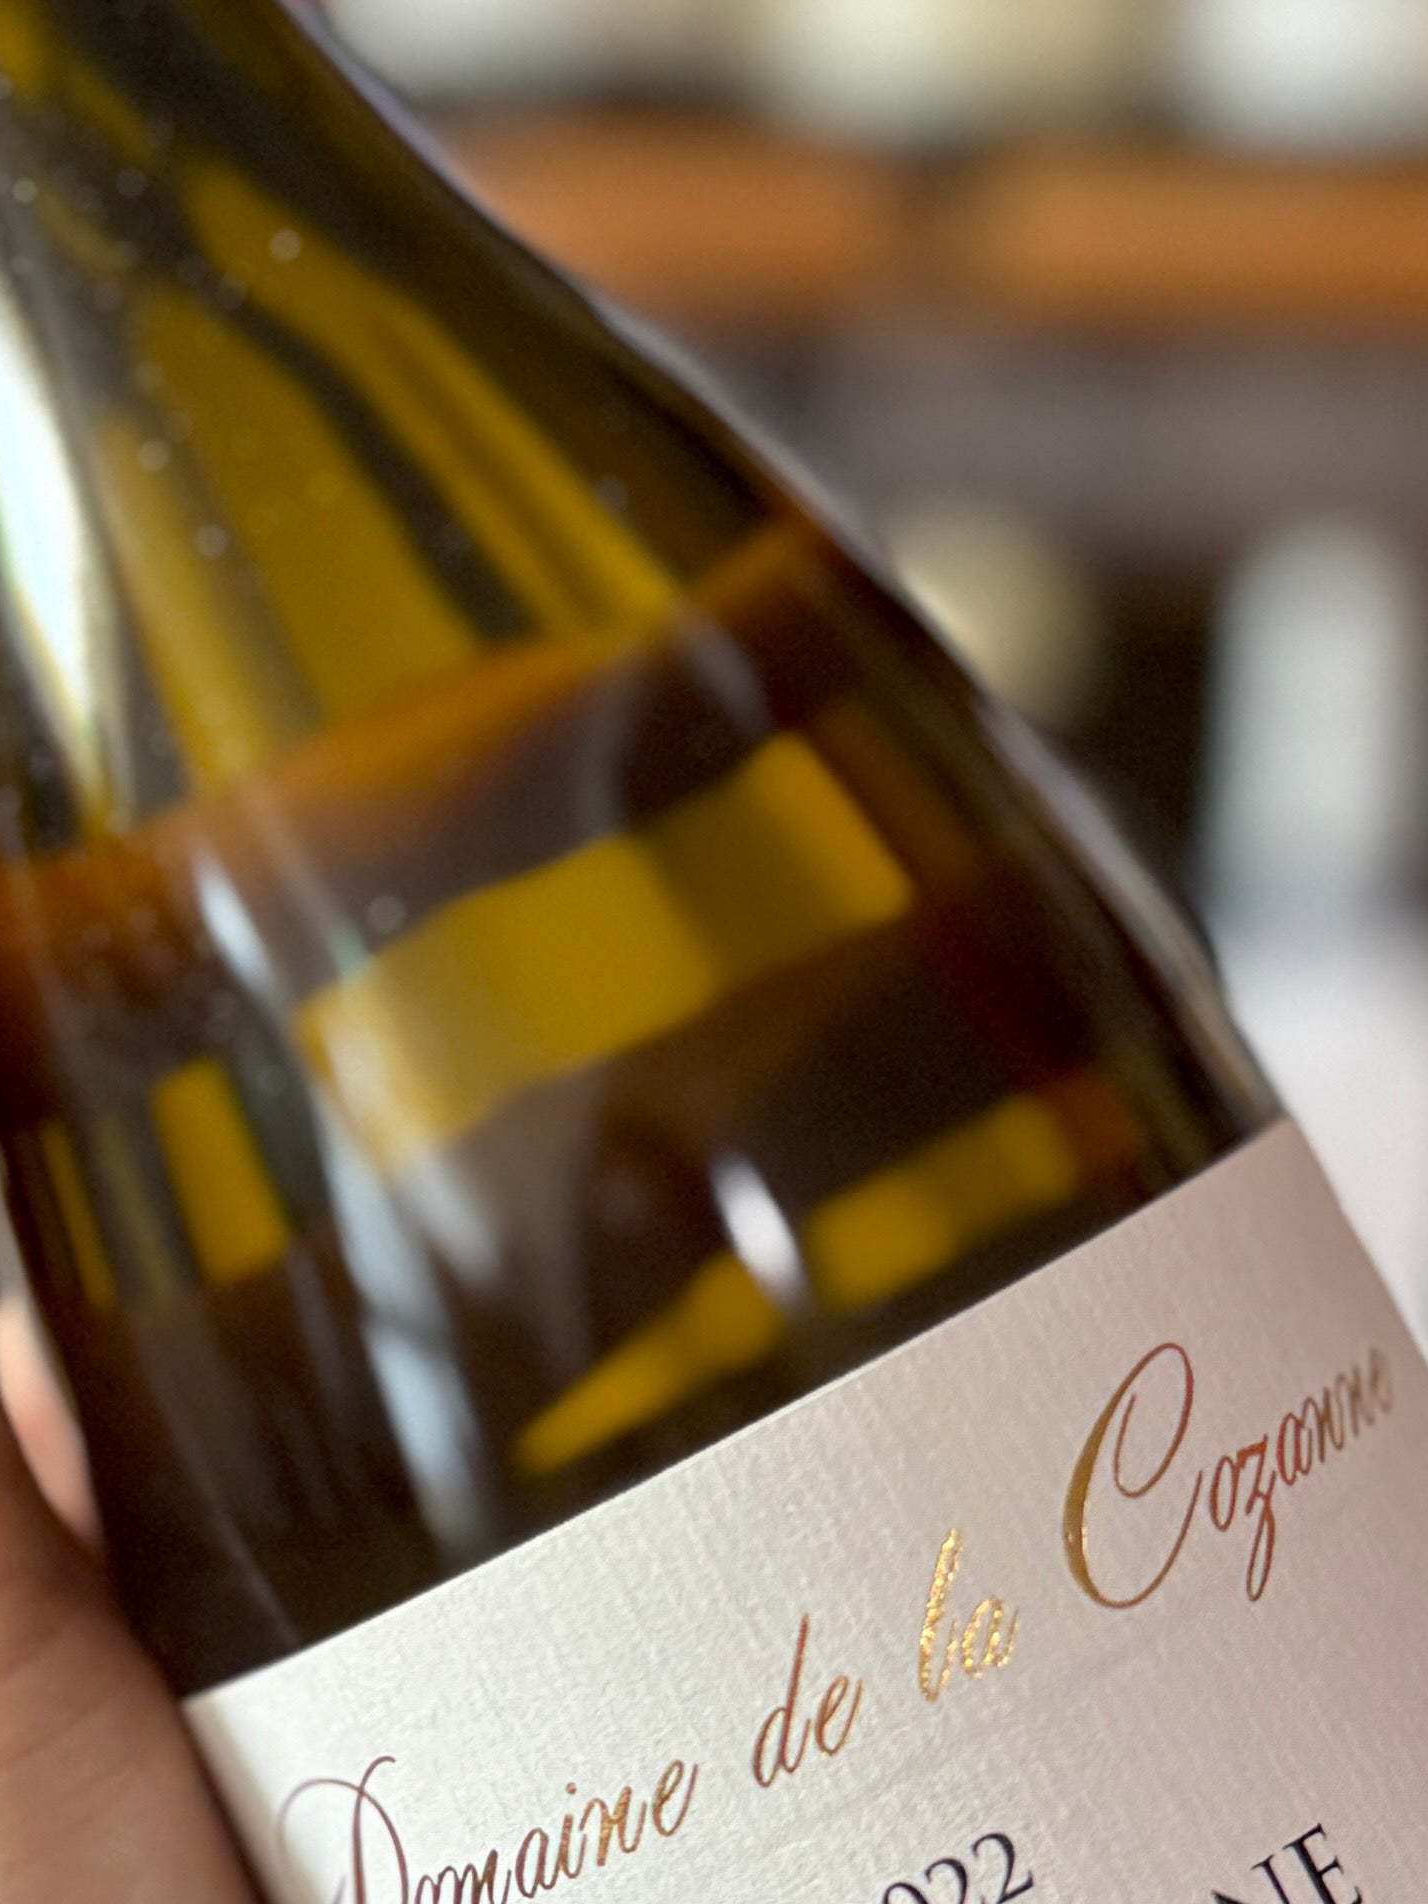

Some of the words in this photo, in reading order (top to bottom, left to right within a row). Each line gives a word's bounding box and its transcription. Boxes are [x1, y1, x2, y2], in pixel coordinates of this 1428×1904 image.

[752, 1615, 863, 1788] de
[917, 1527, 1020, 1703] la
[1061, 1342, 1397, 1610] Cozanne
